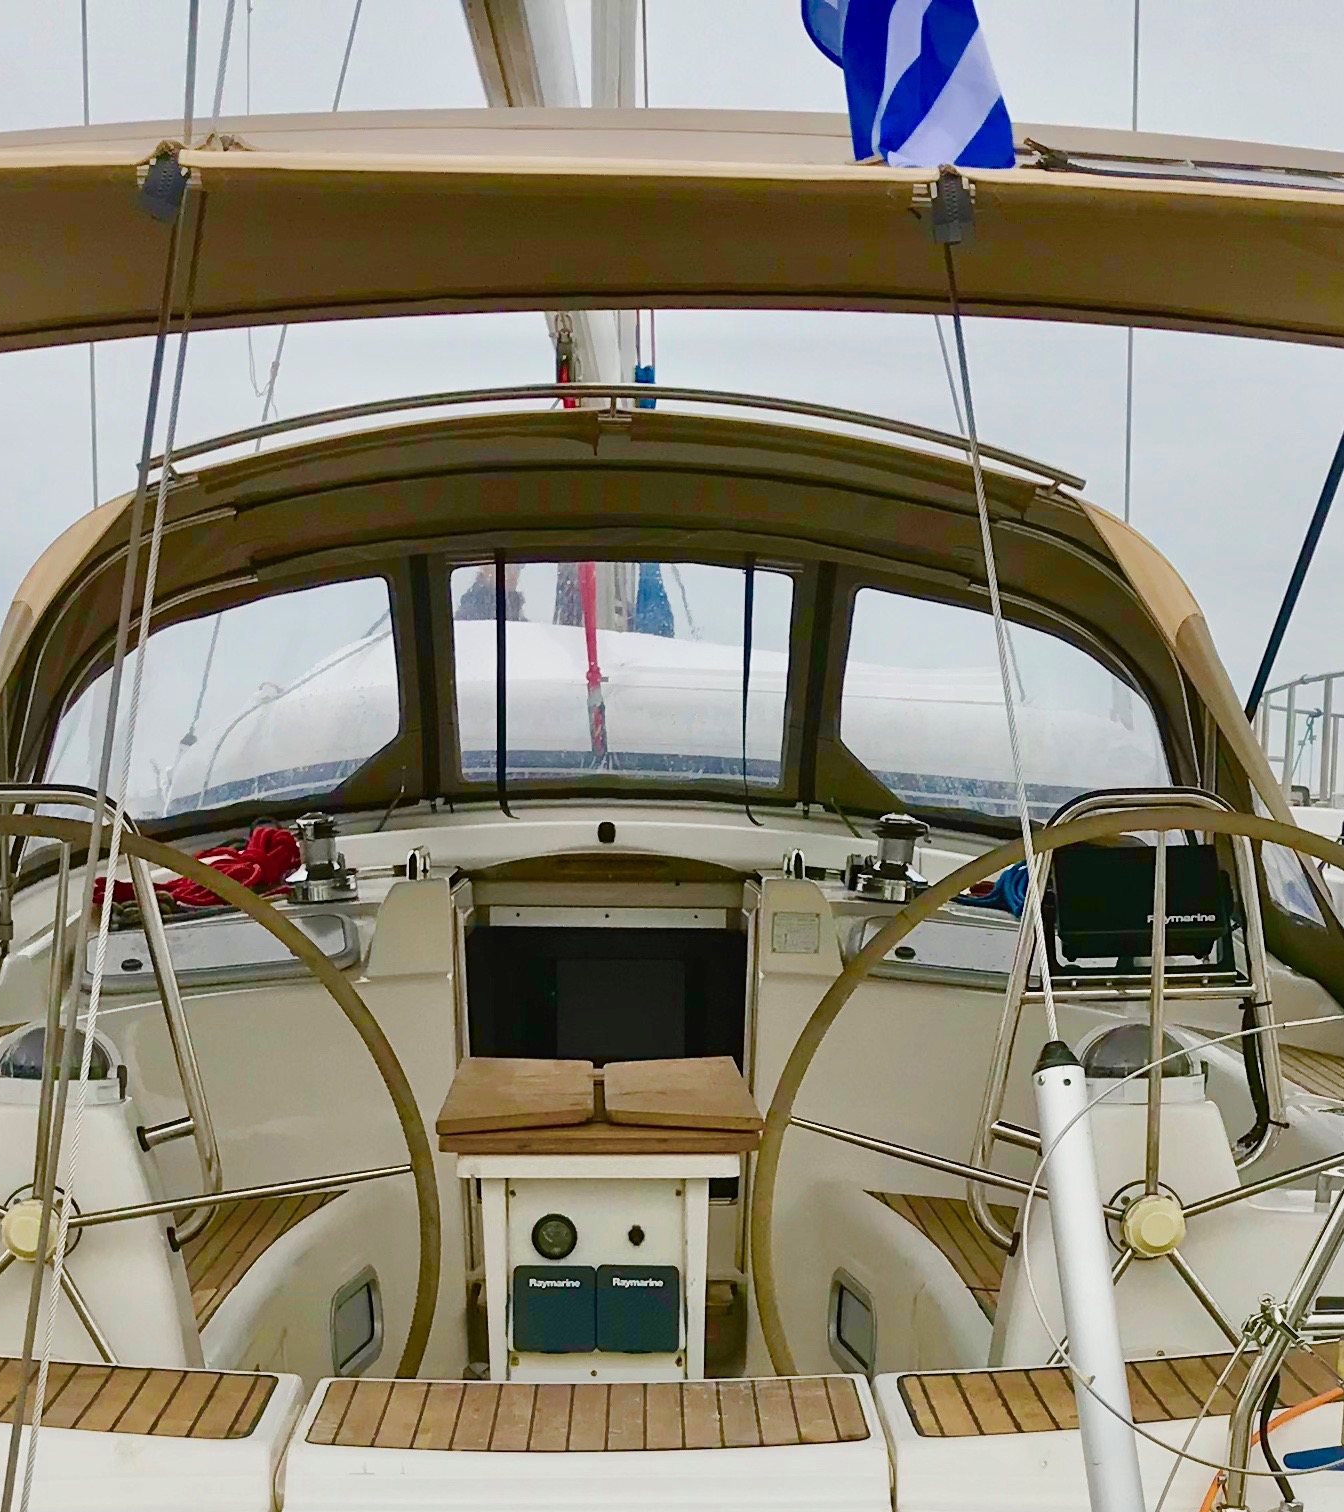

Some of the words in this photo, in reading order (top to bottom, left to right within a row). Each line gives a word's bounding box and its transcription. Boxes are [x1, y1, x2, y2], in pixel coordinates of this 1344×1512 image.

[1146, 912, 1216, 925] Rymarine
[528, 1278, 581, 1288] Raymarine
[612, 1277, 664, 1288] Raymarine
